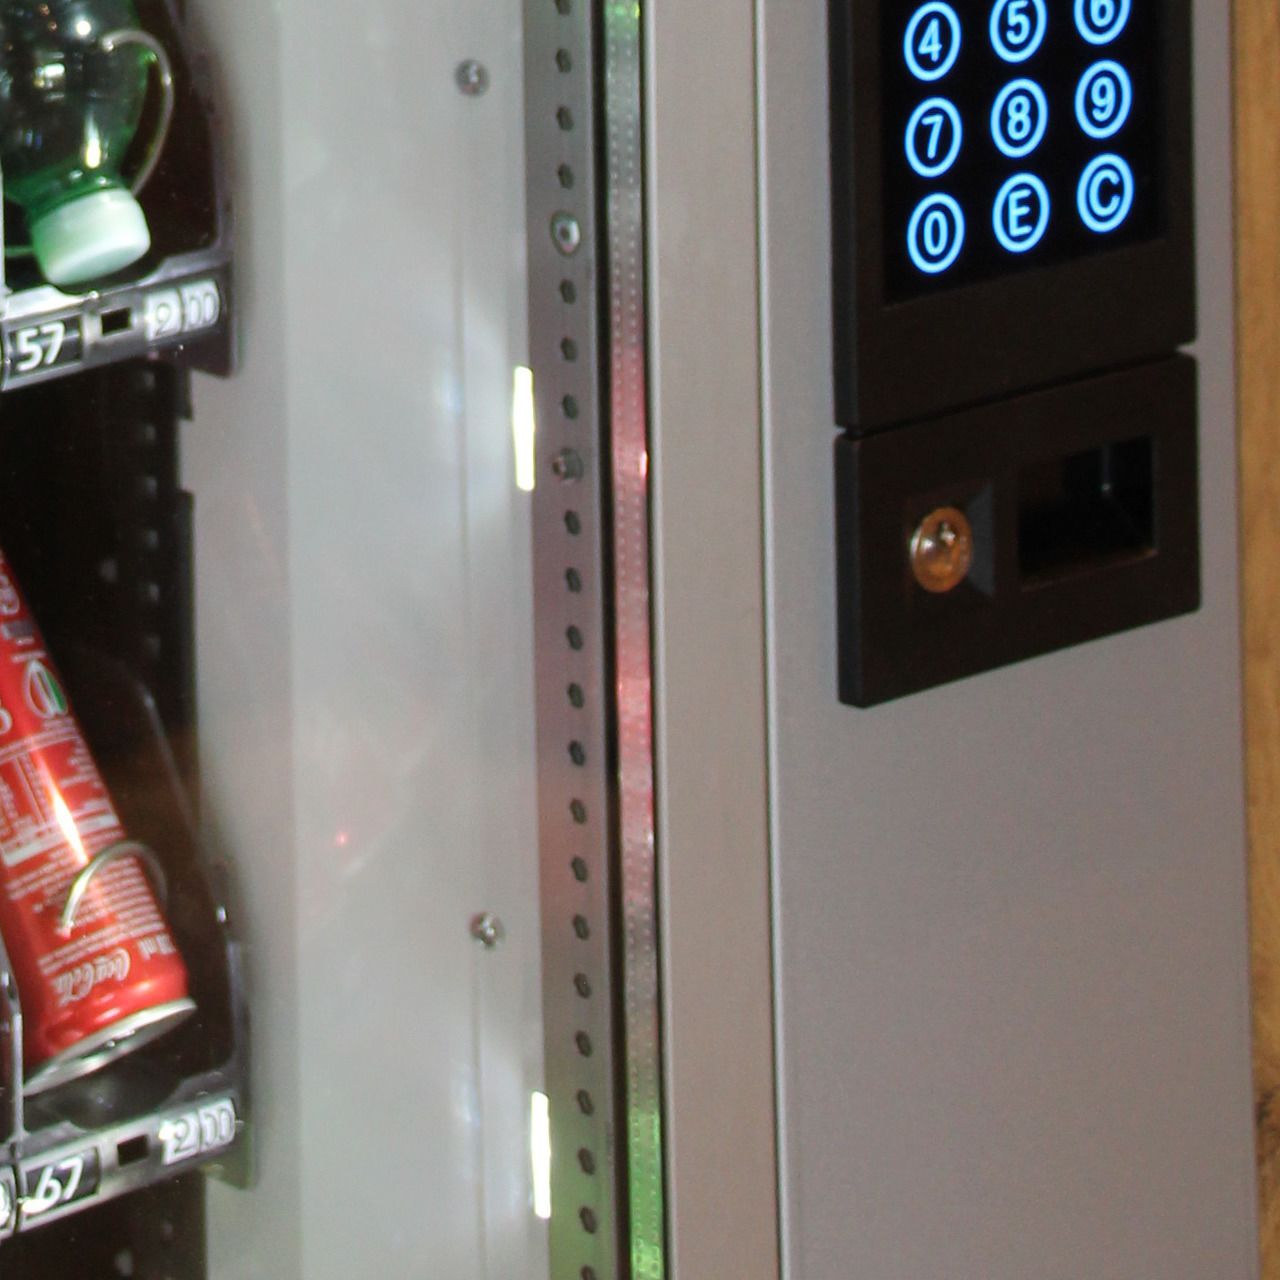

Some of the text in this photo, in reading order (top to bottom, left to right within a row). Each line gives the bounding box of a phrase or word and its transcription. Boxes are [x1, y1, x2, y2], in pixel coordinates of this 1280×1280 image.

[918, 18, 943, 62] 4
[1005, 0, 1031, 45] 5
[1006, 95, 1032, 141] 8
[1090, 75, 1116, 122] 9
[921, 114, 944, 160] 7
[1007, 188, 1034, 238] E
[1089, 168, 1121, 218] C
[923, 210, 949, 257] 0
[15, 320, 67, 372] 57
[32, 1154, 86, 1214] 67
